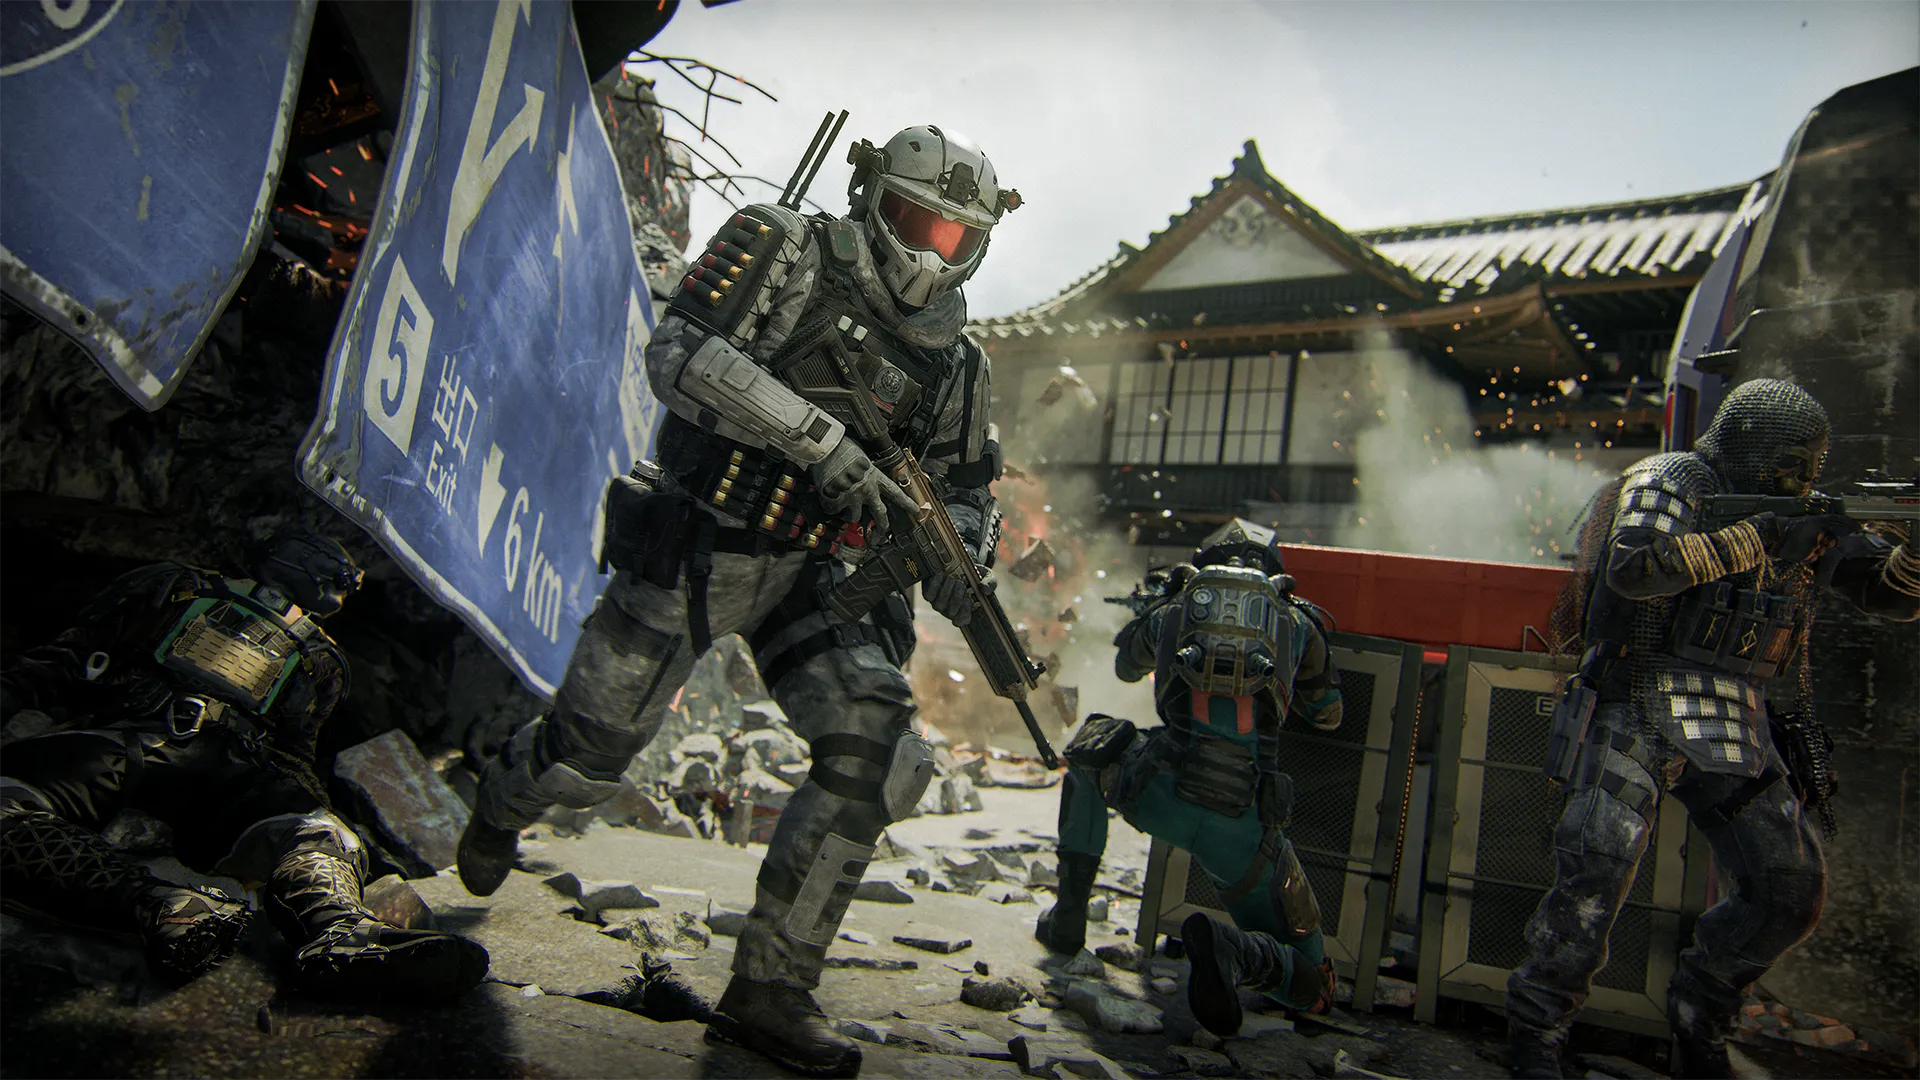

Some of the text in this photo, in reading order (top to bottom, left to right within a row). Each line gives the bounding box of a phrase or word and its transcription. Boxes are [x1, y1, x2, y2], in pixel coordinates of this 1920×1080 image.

[380, 293, 418, 418] 5
[431, 354, 479, 466] 出口
[425, 439, 457, 517] Exit
[504, 486, 563, 644] 6 km
